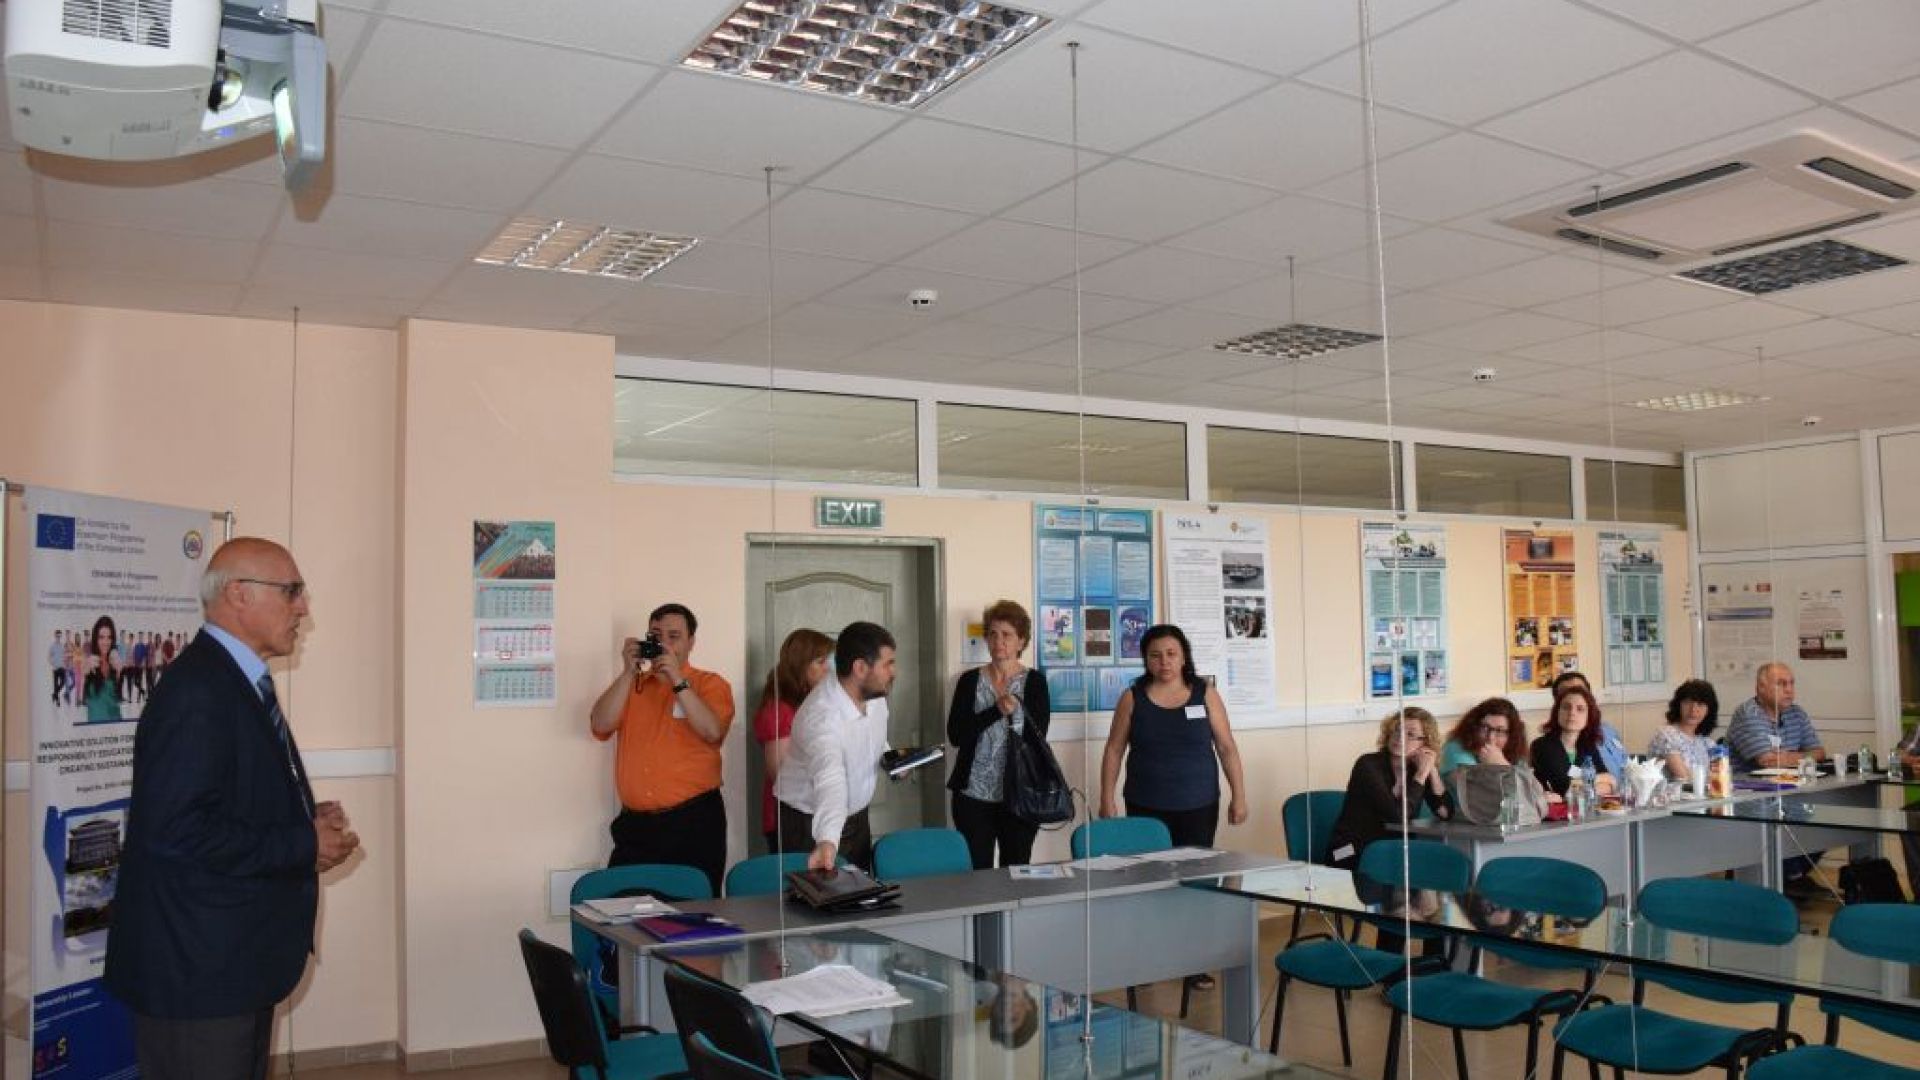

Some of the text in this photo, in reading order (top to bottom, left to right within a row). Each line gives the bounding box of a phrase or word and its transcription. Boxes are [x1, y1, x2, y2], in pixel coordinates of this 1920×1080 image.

[825, 500, 877, 524] EXIT
[98, 747, 134, 758] EDUCATIO
[97, 759, 134, 770] SUSTAINAB
